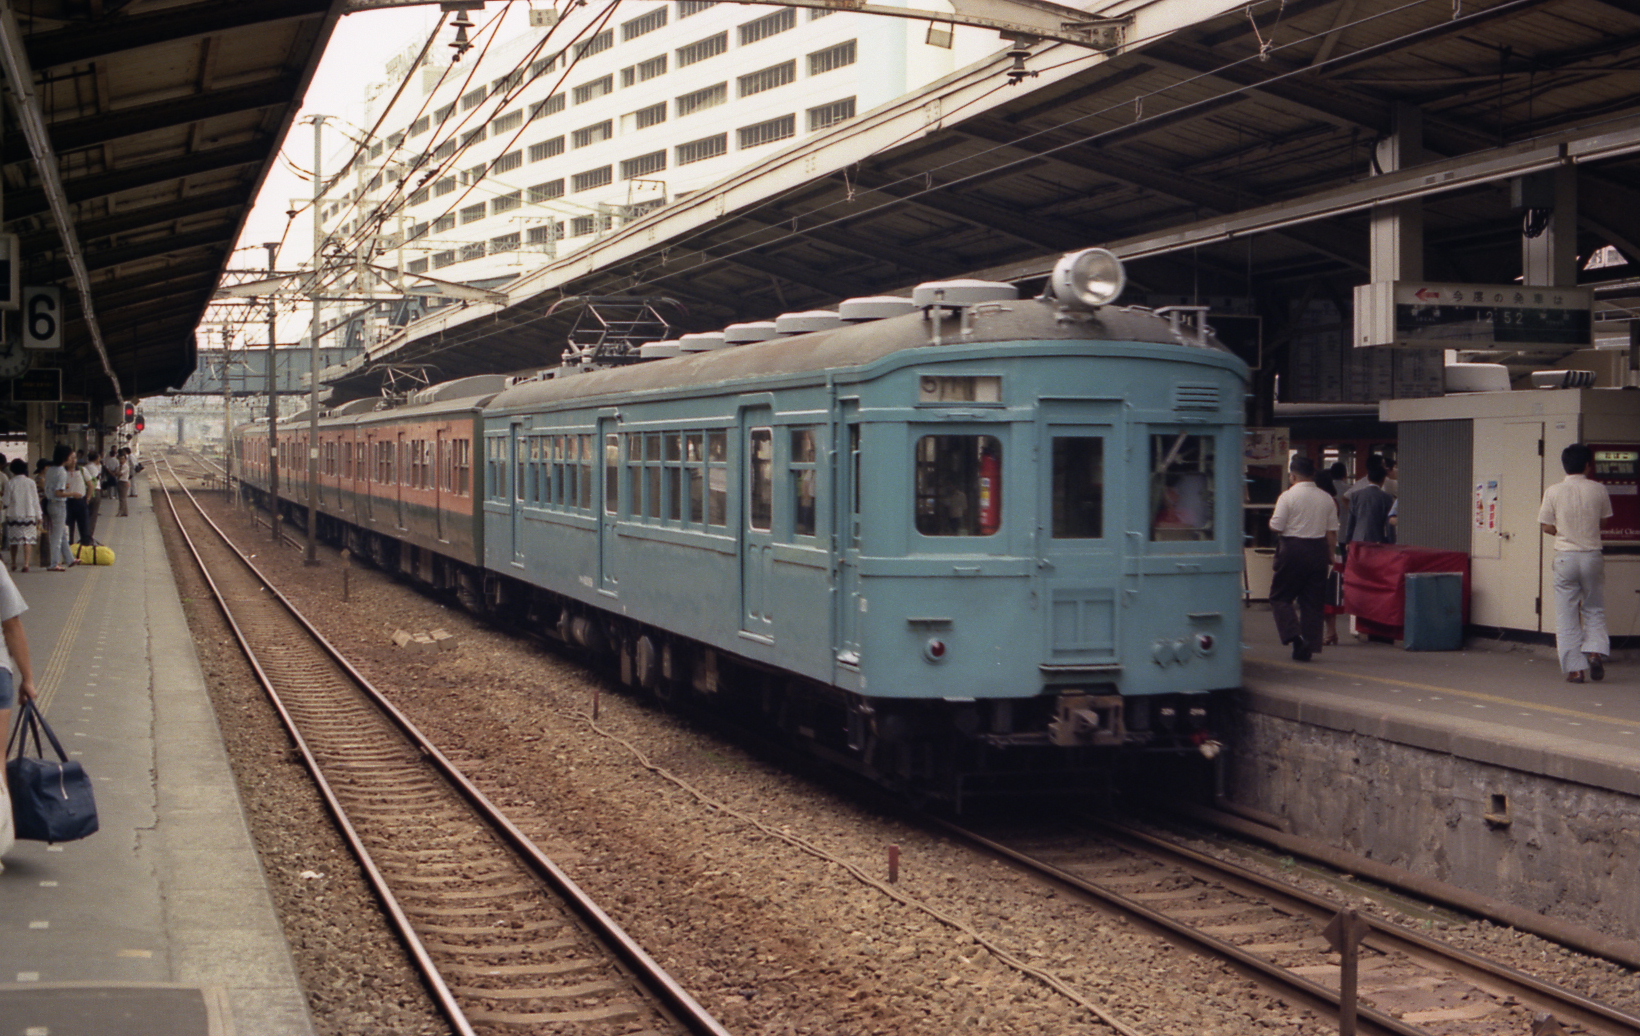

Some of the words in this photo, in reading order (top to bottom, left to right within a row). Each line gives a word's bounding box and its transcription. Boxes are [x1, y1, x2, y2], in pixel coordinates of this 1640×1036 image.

[1452, 290, 1563, 305] 今度の発車は
[28, 294, 55, 341] 6
